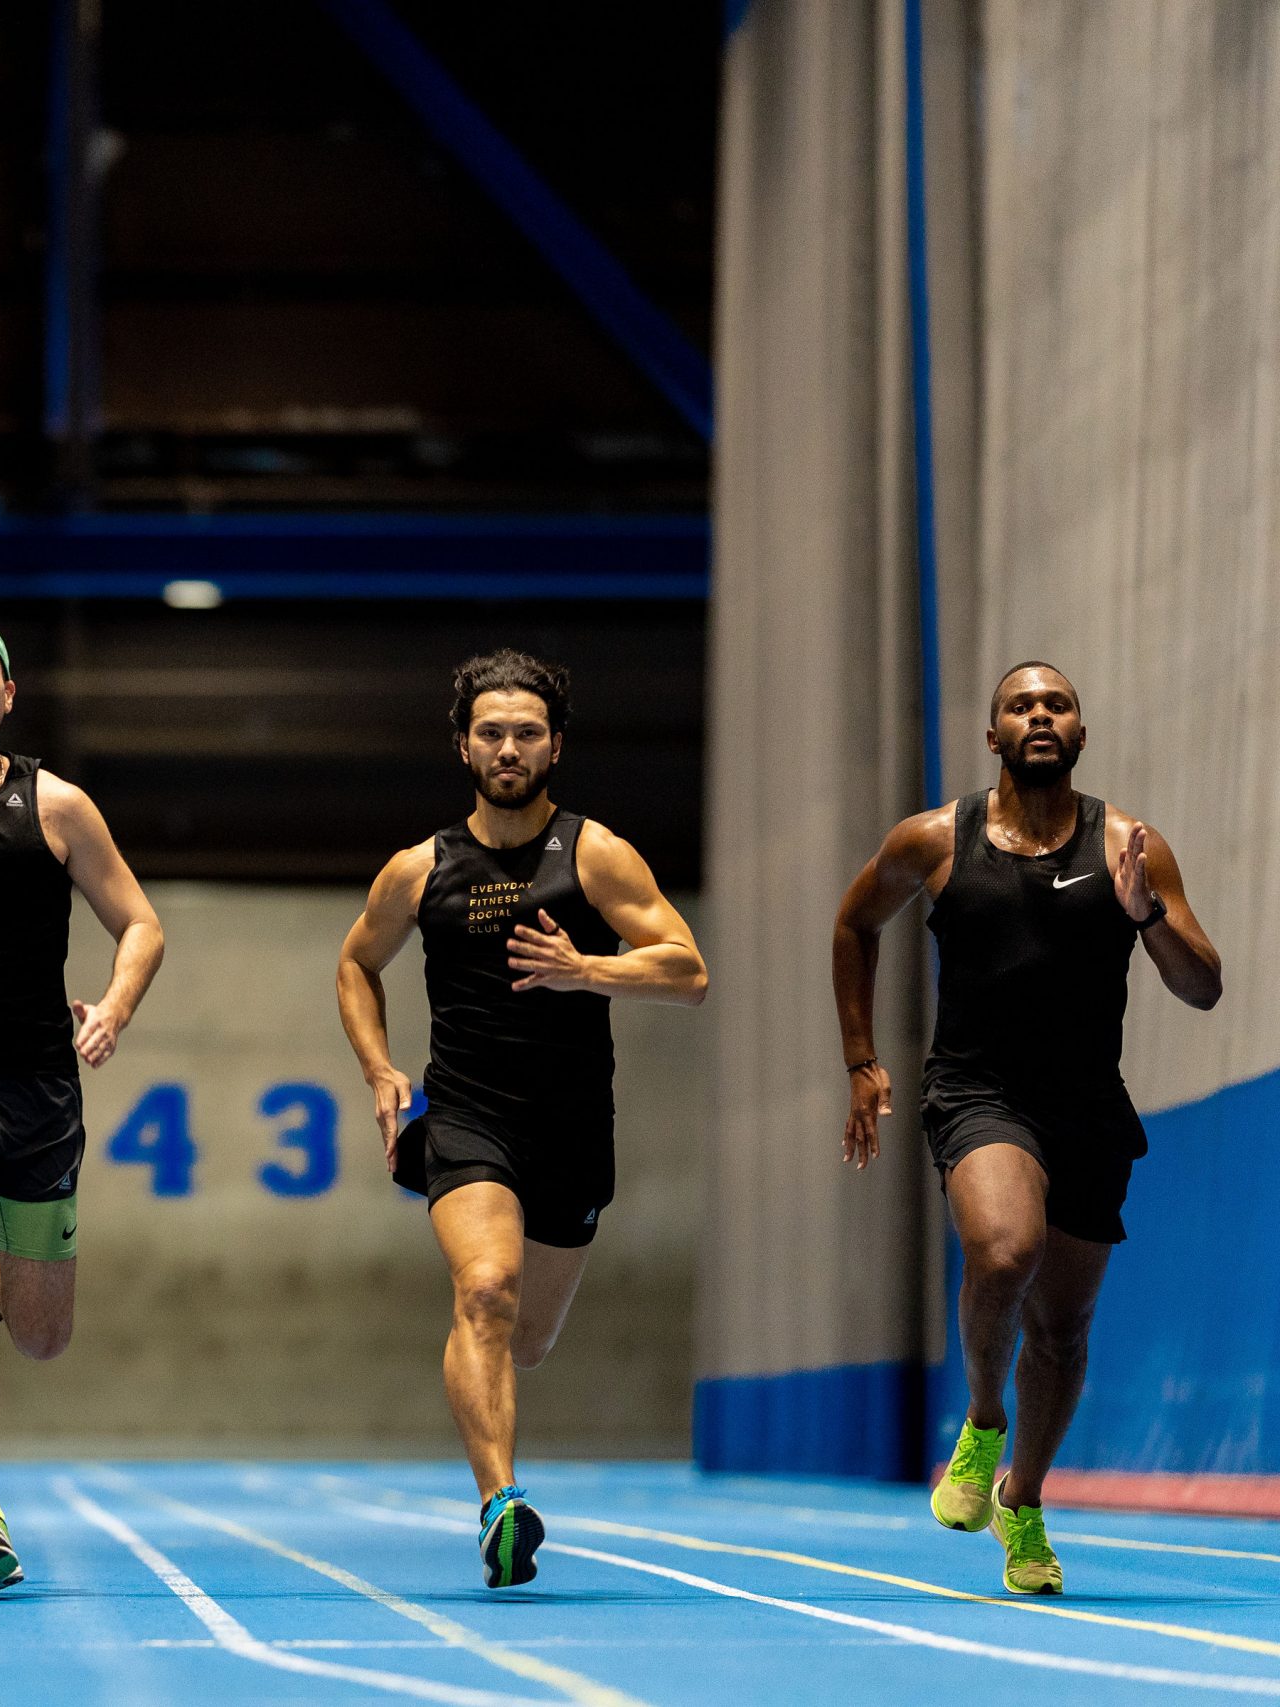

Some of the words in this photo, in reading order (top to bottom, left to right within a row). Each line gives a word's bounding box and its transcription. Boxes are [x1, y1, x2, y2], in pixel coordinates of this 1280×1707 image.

[471, 882, 534, 894] EVERYDAY
[469, 895, 520, 907] FITNESS
[468, 909, 512, 920] SOCIAL
[468, 924, 500, 934] CLUB
[108, 1084, 194, 1195] 4
[258, 1083, 337, 1194] 3
